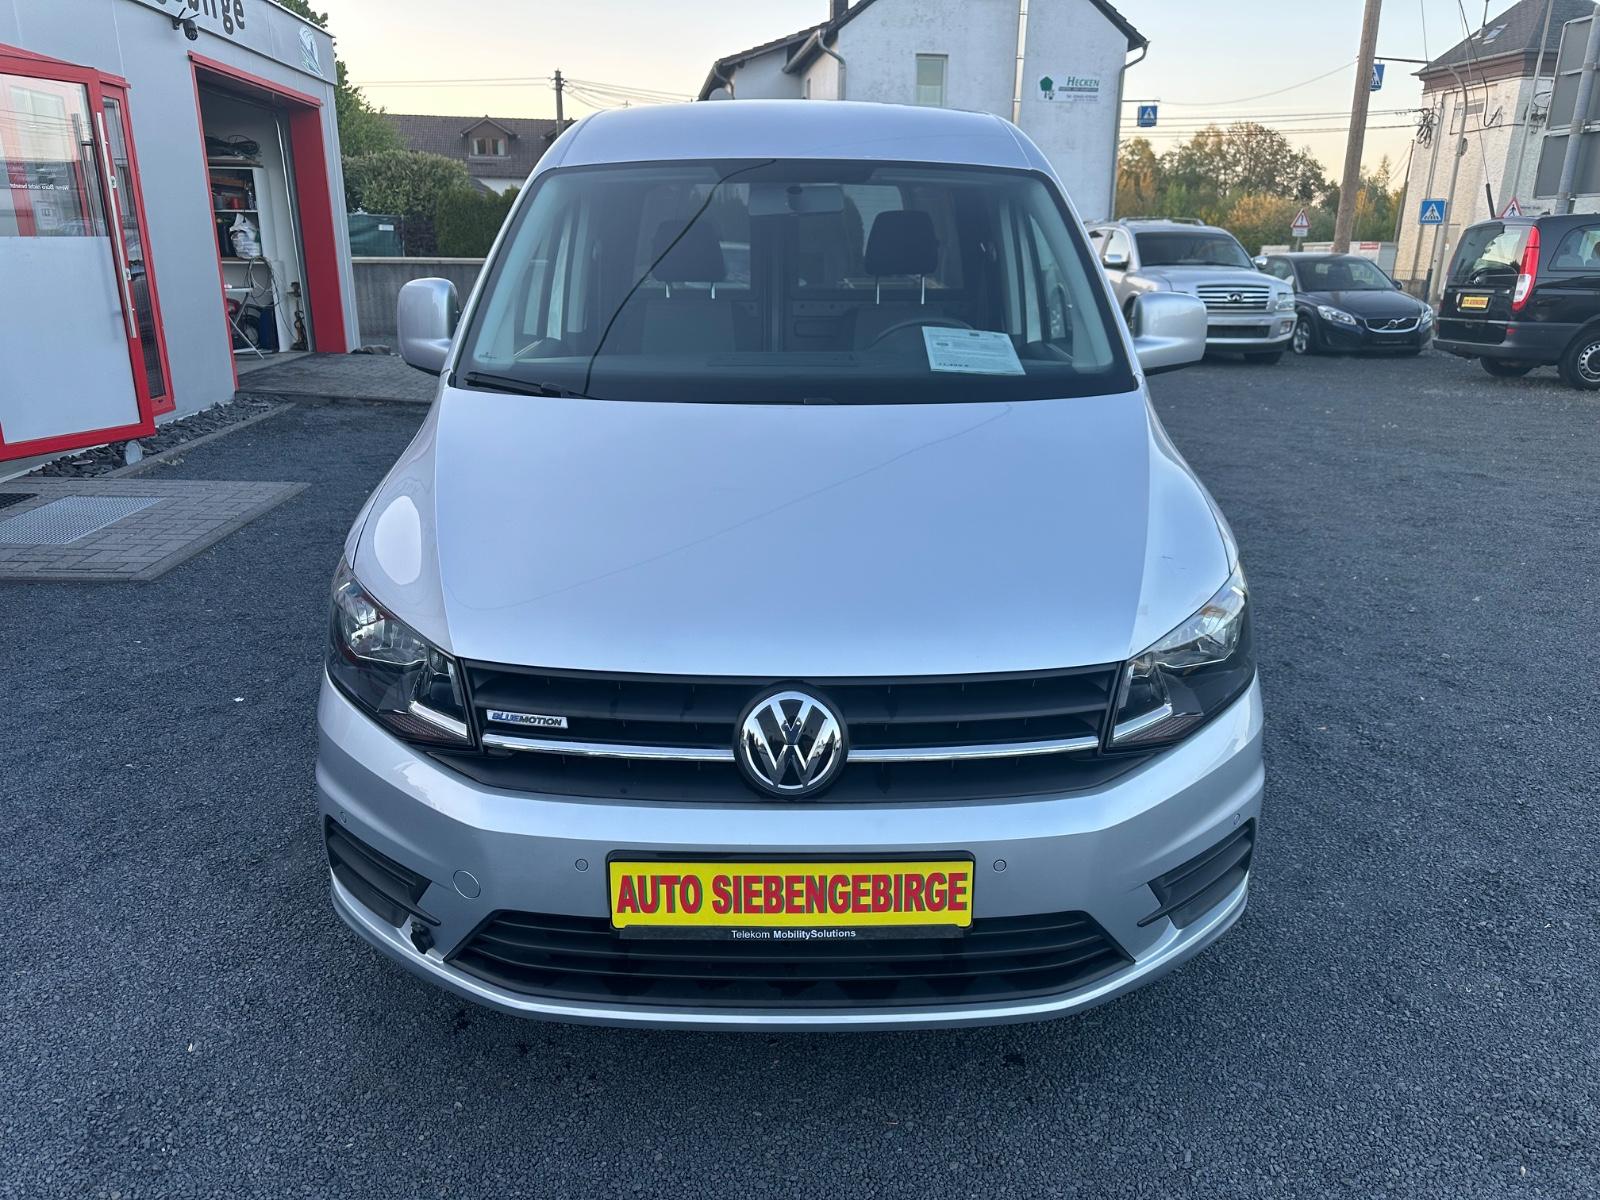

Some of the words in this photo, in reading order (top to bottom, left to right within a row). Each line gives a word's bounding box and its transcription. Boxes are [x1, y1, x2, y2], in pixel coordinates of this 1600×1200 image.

[1066, 76, 1100, 87] HECKEN
[491, 712, 562, 726] BLUEMOTION
[616, 874, 703, 914] AUTO
[711, 872, 968, 914] SIEBENGEBIRGE
[731, 930, 770, 939] Telekom
[773, 929, 857, 940] MobilitySolutions
